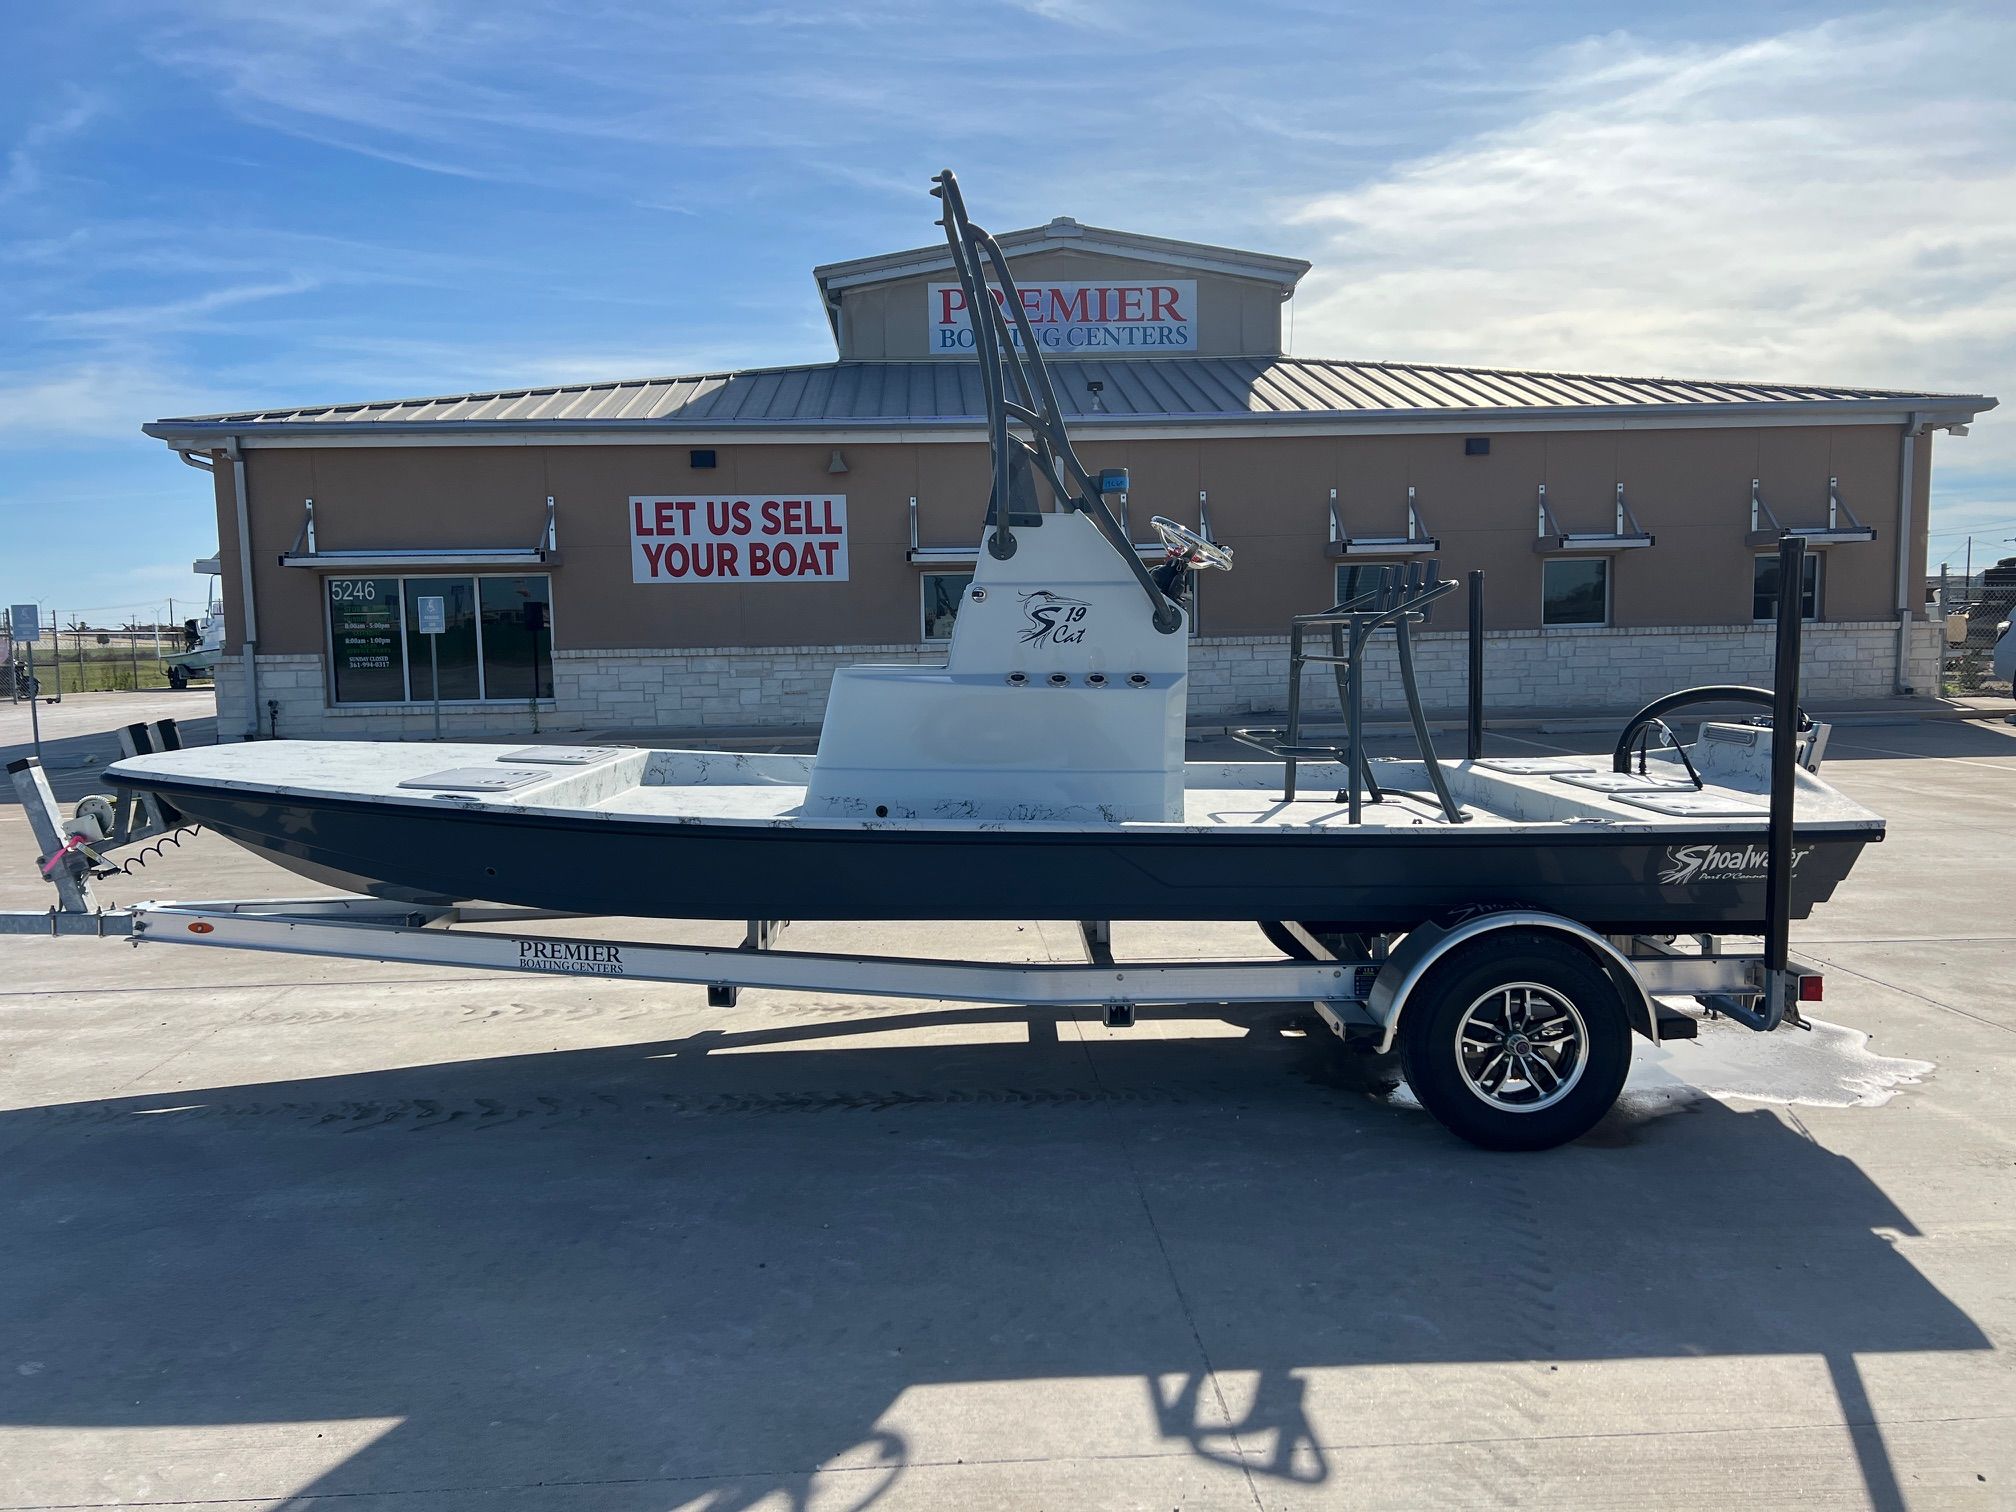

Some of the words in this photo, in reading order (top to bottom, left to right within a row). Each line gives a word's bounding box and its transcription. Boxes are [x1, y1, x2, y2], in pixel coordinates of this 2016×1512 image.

[1066, 325, 1188, 346] CENTERS
[634, 501, 696, 536] LET
[706, 501, 752, 536] US
[761, 500, 843, 535] SELL
[641, 542, 740, 578] YOUR
[749, 541, 839, 577] BOAT
[332, 581, 375, 600] 5246
[1065, 606, 1087, 623] 19
[1052, 624, 1086, 644] Cat
[519, 941, 623, 964] PREMIER
[519, 958, 570, 971] BOATING
[571, 961, 624, 974] CENTERS
